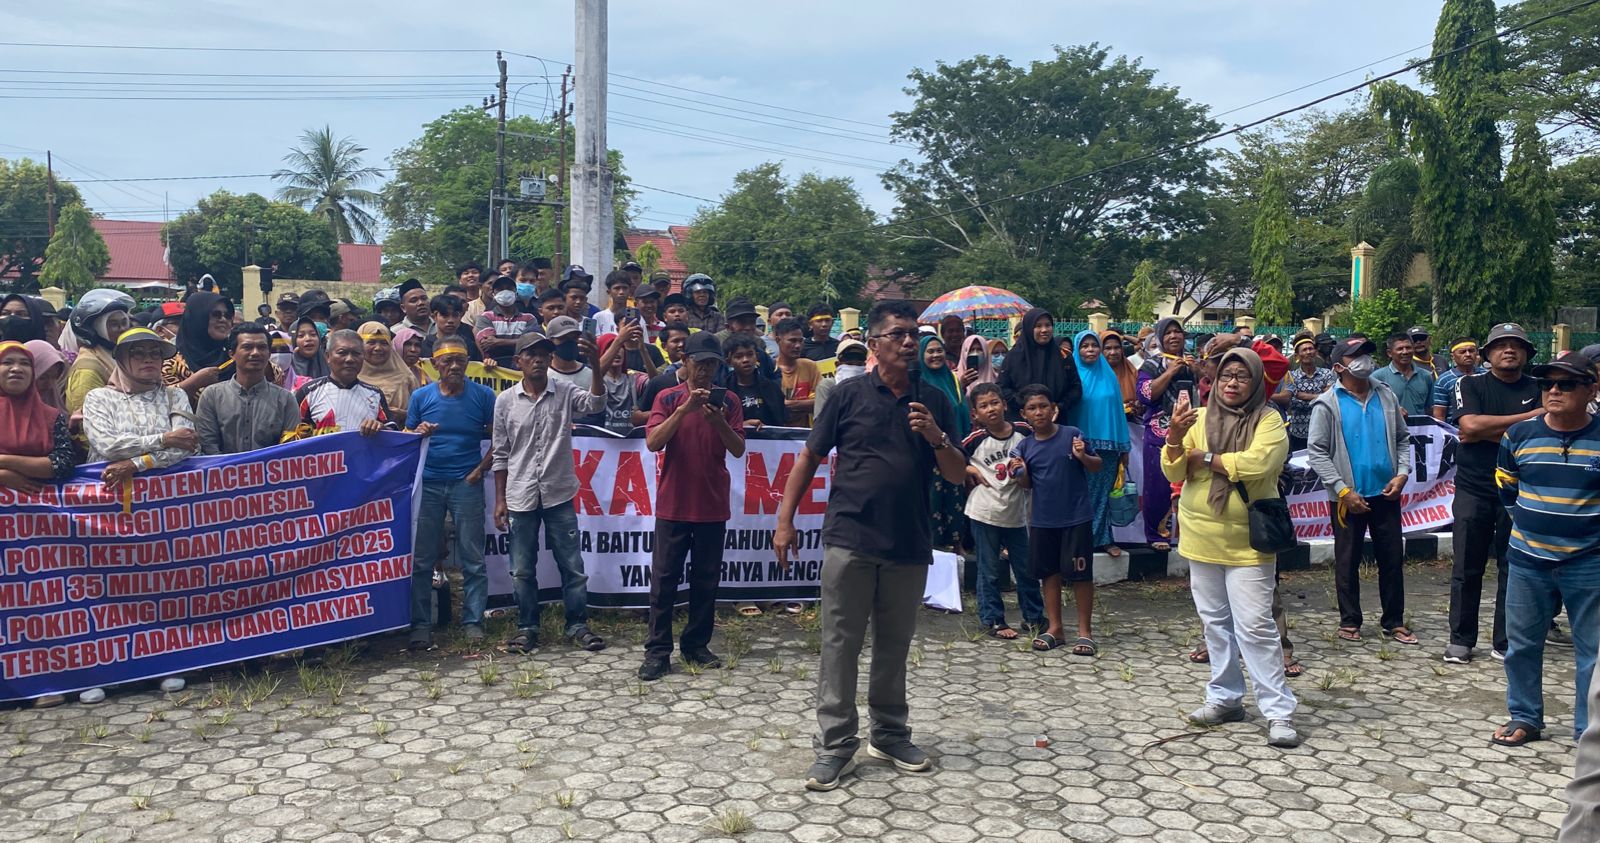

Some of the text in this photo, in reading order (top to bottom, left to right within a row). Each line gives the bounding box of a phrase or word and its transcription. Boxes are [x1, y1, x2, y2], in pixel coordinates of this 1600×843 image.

[207, 461, 265, 492] ACEH
[266, 450, 347, 483] SINGKIL
[5, 543, 87, 575] POKIR
[89, 540, 172, 568] KETUA
[173, 532, 222, 561] DAN
[224, 515, 324, 554] ANGGOTA
[323, 498, 394, 536] DEWAN
[72, 508, 162, 539] TINGGI
[163, 503, 191, 532] DI
[193, 486, 314, 526] INDONESIA.
[67, 574, 104, 602] 35
[107, 565, 206, 597] MILIYAR
[209, 555, 269, 586] PADA
[269, 539, 337, 577] TAHUN
[337, 528, 394, 560] 2025
[768, 560, 823, 581] MENC
[1072, 557, 1087, 571] 10
[1, 592, 374, 679] TERSEBUT ADALAH UANG RAKYAT.
[8, 608, 90, 644] POKIR
[90, 601, 157, 632] YANG
[159, 597, 188, 622] DI
[190, 578, 294, 618] RASAKAN
